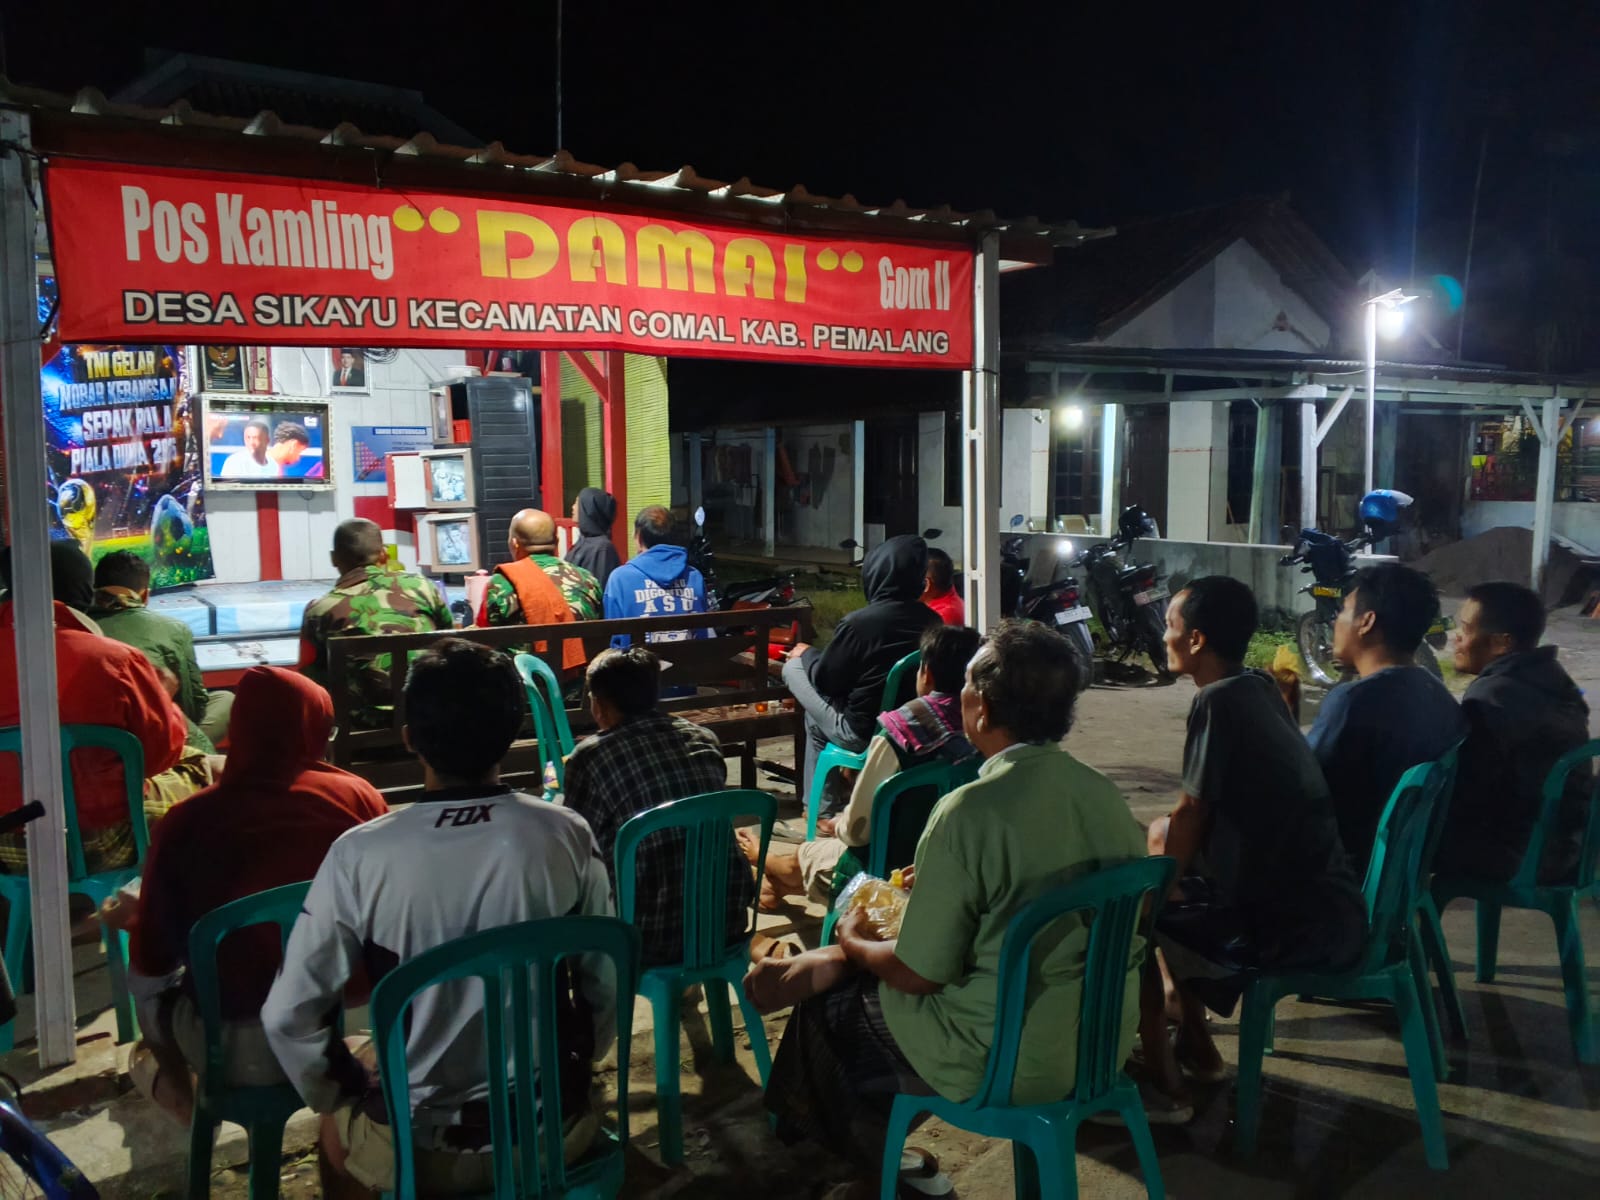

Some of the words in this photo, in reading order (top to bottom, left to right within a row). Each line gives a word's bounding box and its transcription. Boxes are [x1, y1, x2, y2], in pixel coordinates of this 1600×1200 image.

[121, 186, 208, 264] Pos
[215, 192, 394, 280] Kamling
[879, 256, 930, 310] Gom
[123, 290, 244, 326] DESA
[254, 294, 398, 328] SIKAYU
[409, 299, 622, 333] KECAMATAN
[628, 309, 735, 343] COMAL
[741, 317, 806, 347] KAB.
[813, 325, 950, 355] PEMALANG
[83, 351, 110, 378] TNI
[112, 350, 155, 377] GELAR
[82, 408, 134, 441] SEPAK
[71, 445, 112, 475] PIALA
[434, 803, 497, 828] FOX
